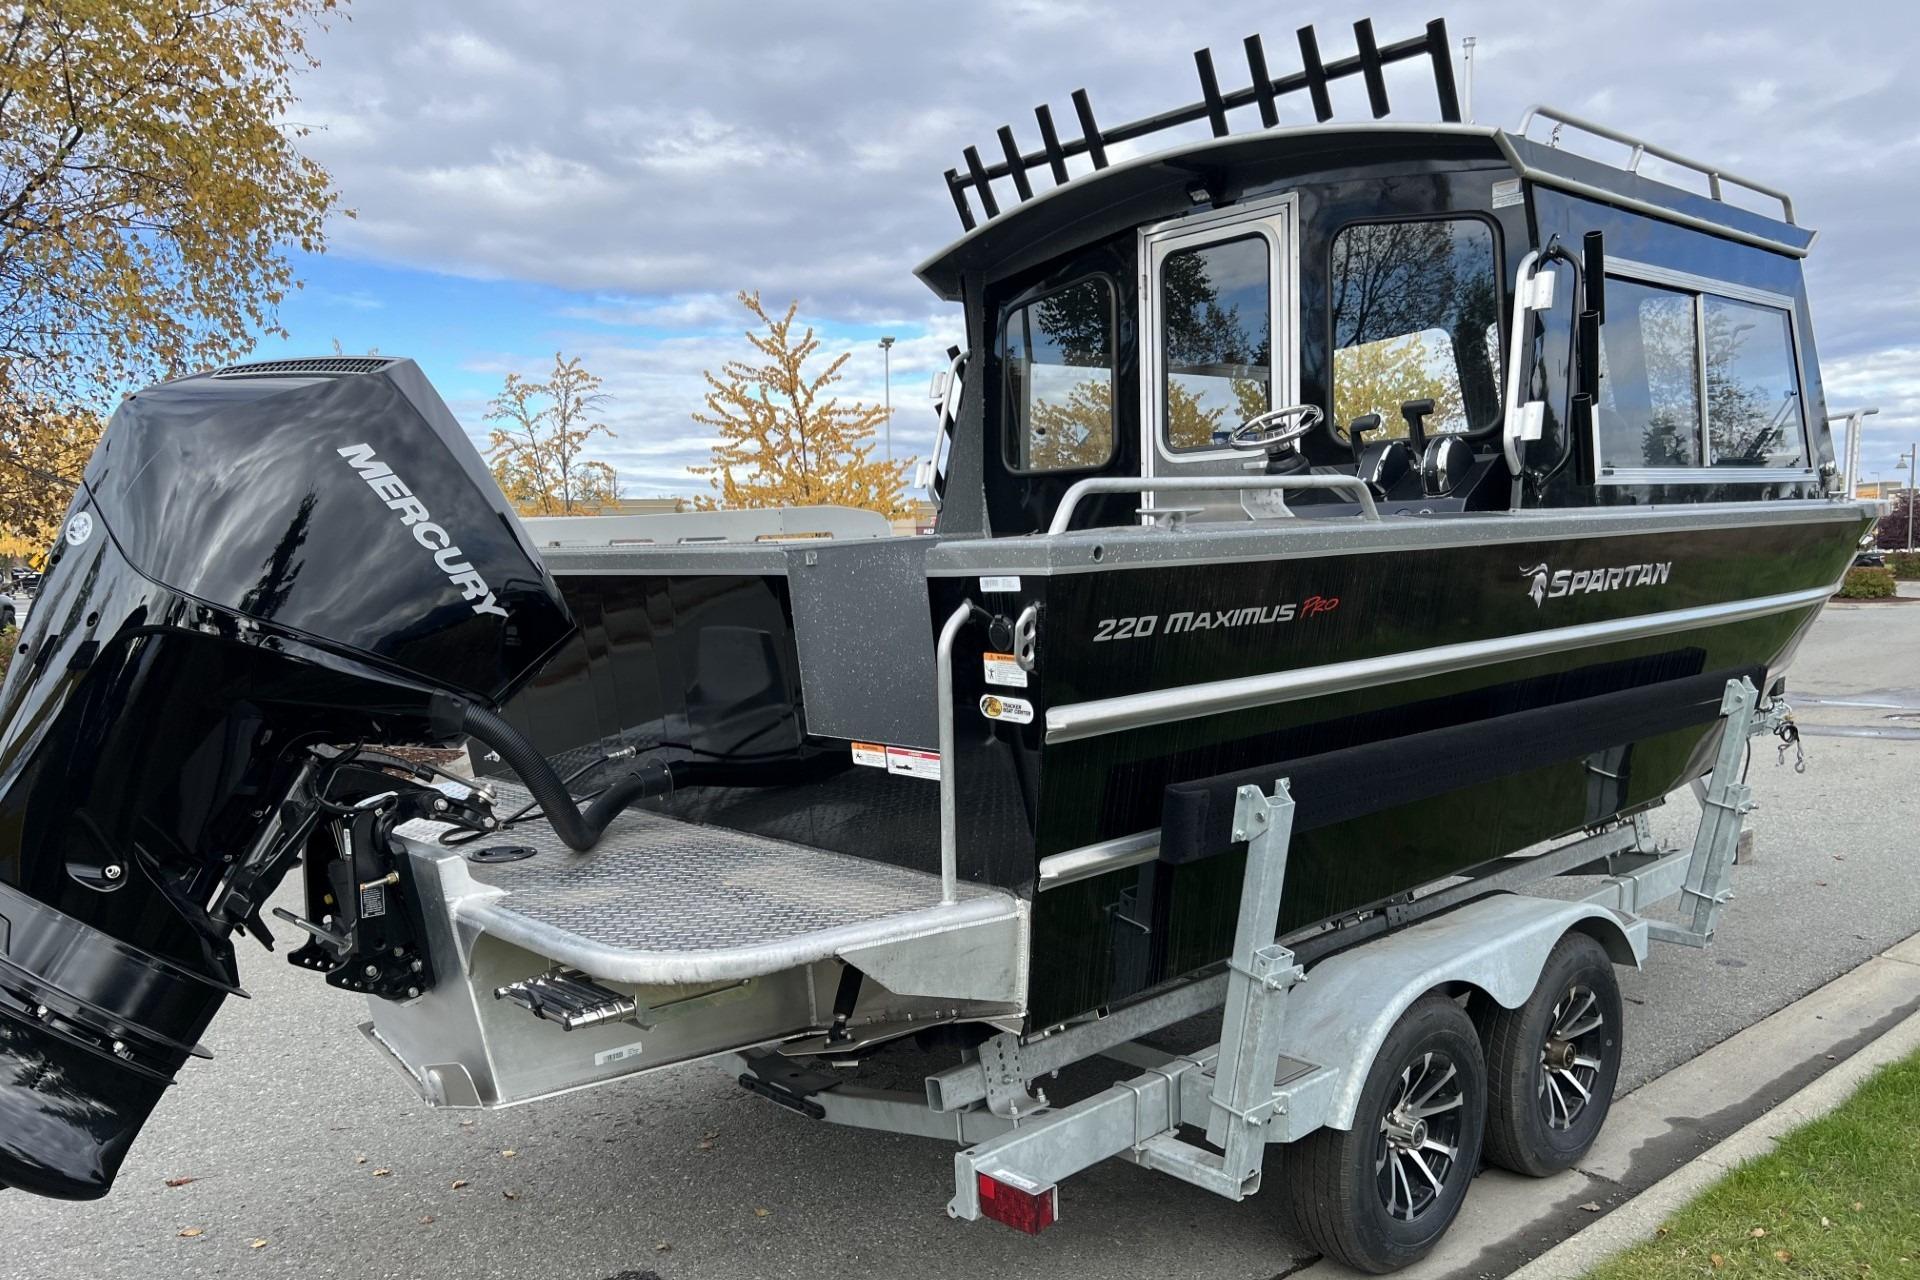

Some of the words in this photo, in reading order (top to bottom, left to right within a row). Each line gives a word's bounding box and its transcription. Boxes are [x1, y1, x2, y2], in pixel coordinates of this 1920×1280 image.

[336, 442, 509, 618] MERCURY
[1547, 561, 1672, 598] SPARTAN
[1093, 615, 1158, 642] 220
[1163, 603, 1297, 634] MAXIMUS
